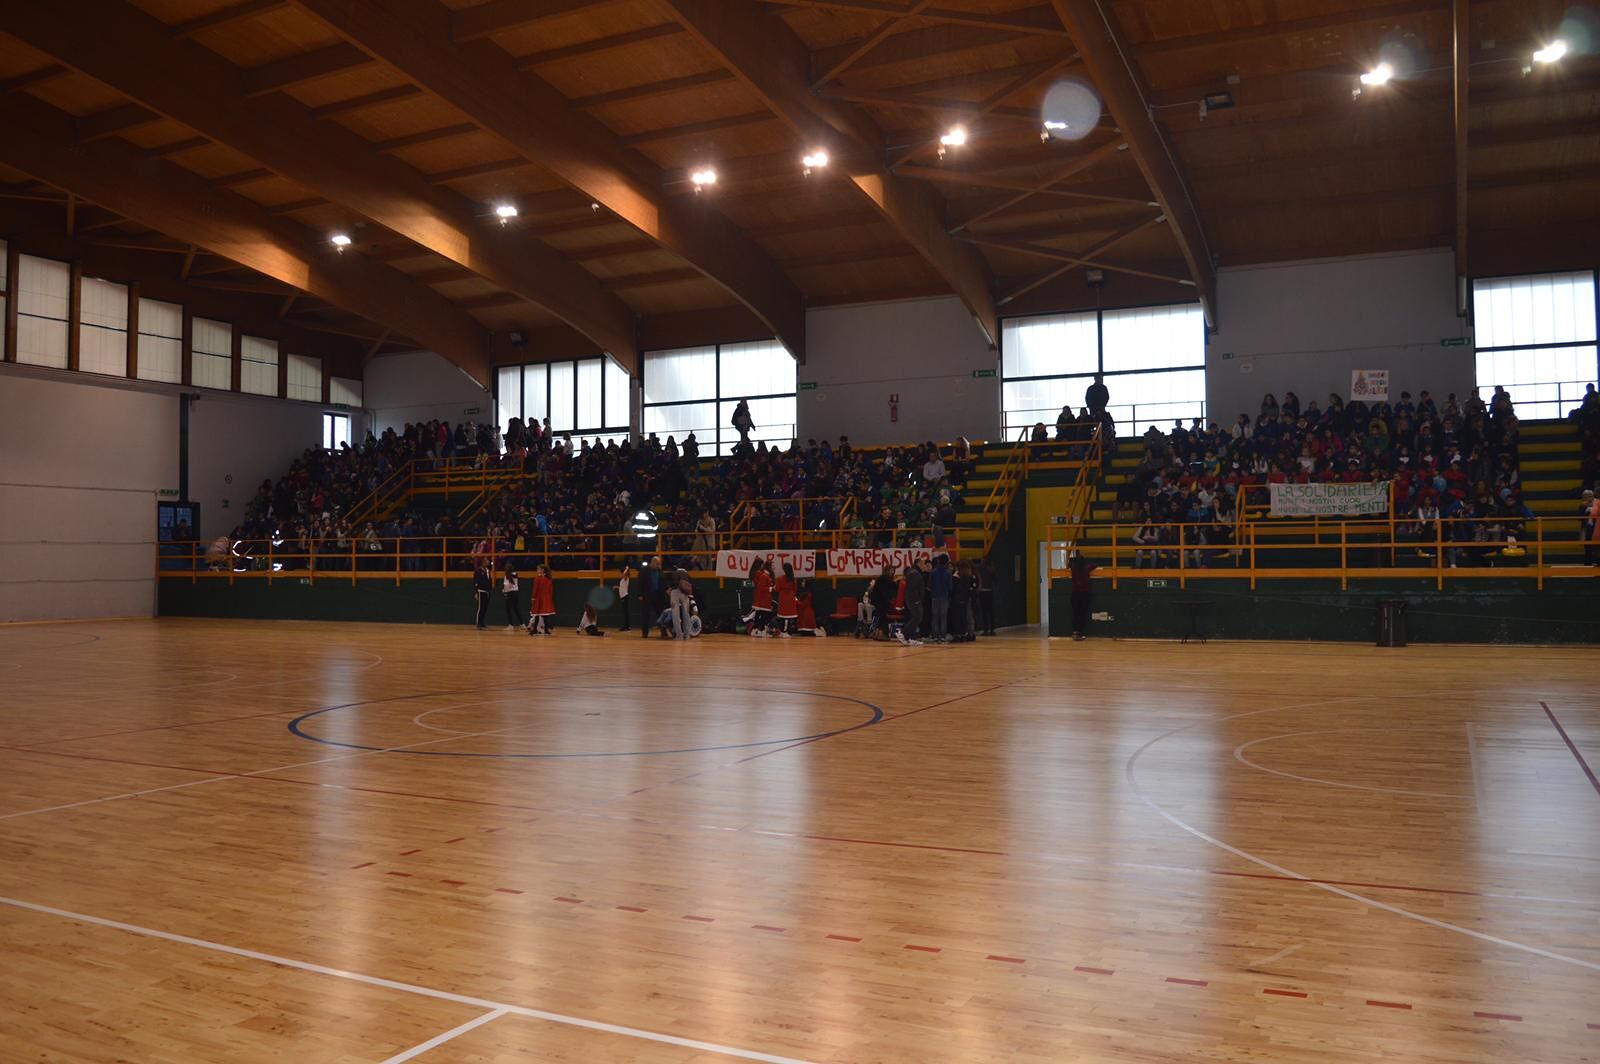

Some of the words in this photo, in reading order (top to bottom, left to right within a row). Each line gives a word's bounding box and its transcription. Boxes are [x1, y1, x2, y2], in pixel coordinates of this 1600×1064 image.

[1277, 485, 1294, 497] LA
[1355, 501, 1386, 513] MENTI
[727, 552, 815, 573] QURTUS
